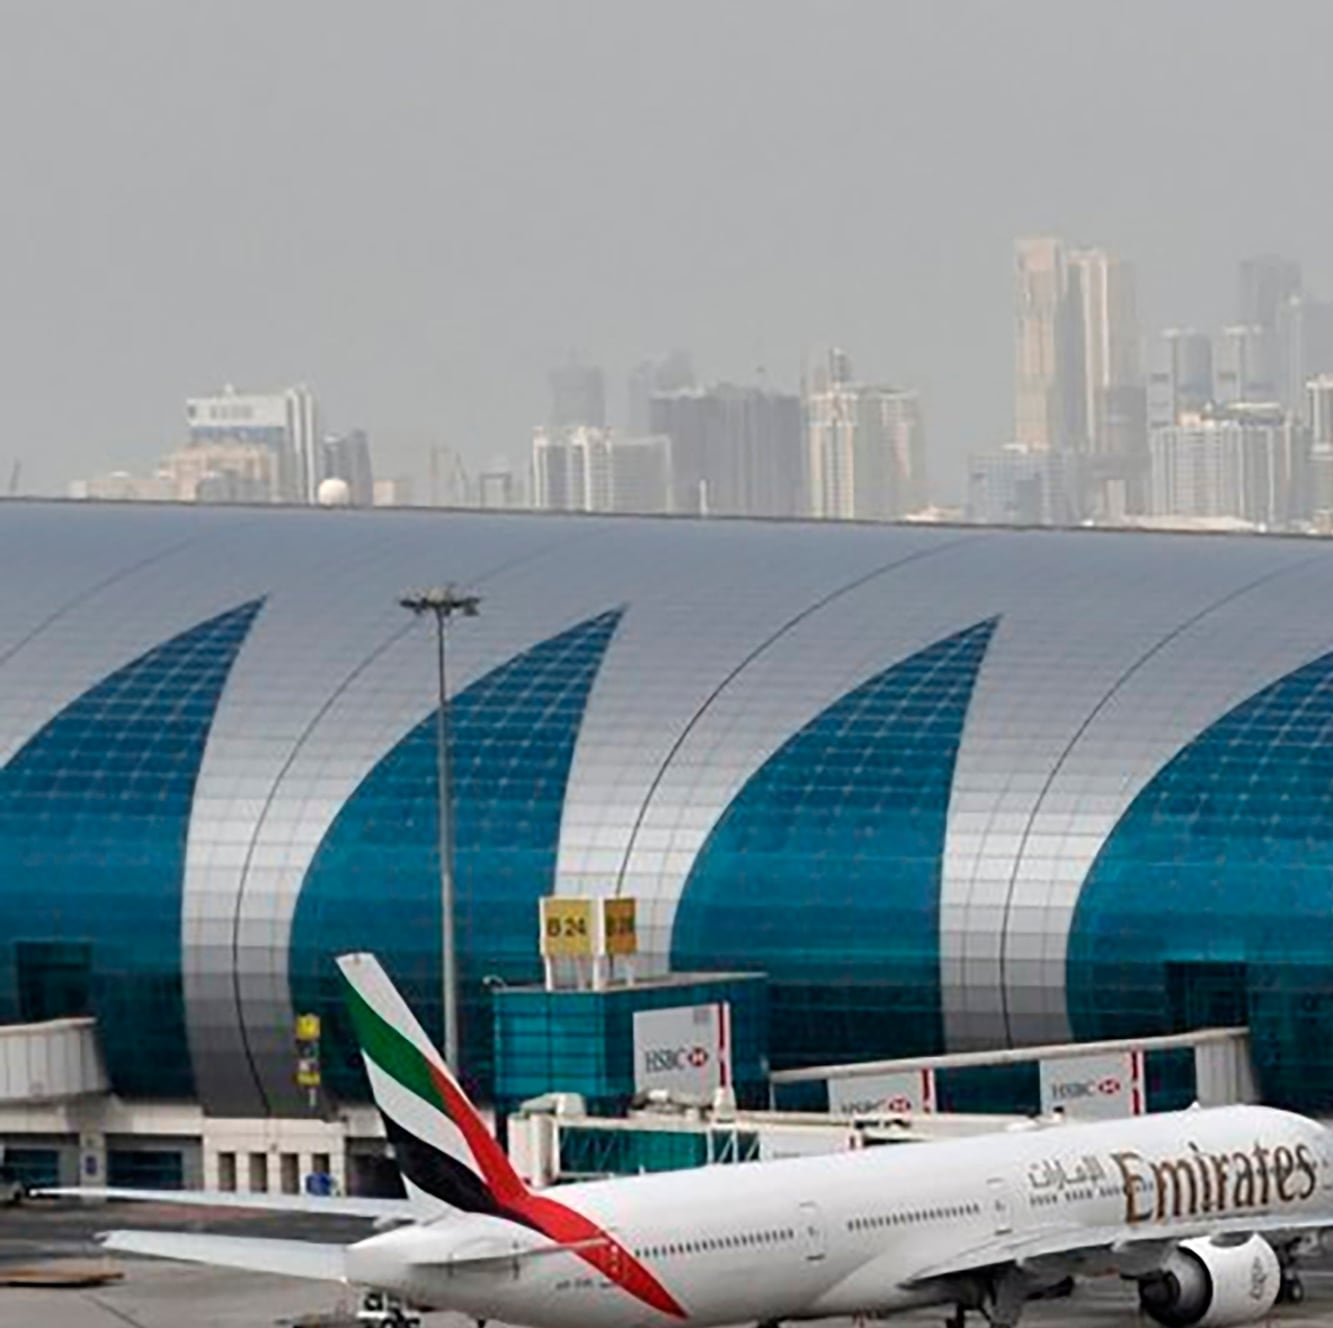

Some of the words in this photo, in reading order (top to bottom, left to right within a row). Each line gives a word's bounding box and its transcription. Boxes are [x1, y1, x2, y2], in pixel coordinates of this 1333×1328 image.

[645, 1047, 687, 1073] HSBC
[1051, 1079, 1095, 1098] HSBC
[1110, 1140, 1316, 1224] Emirates
